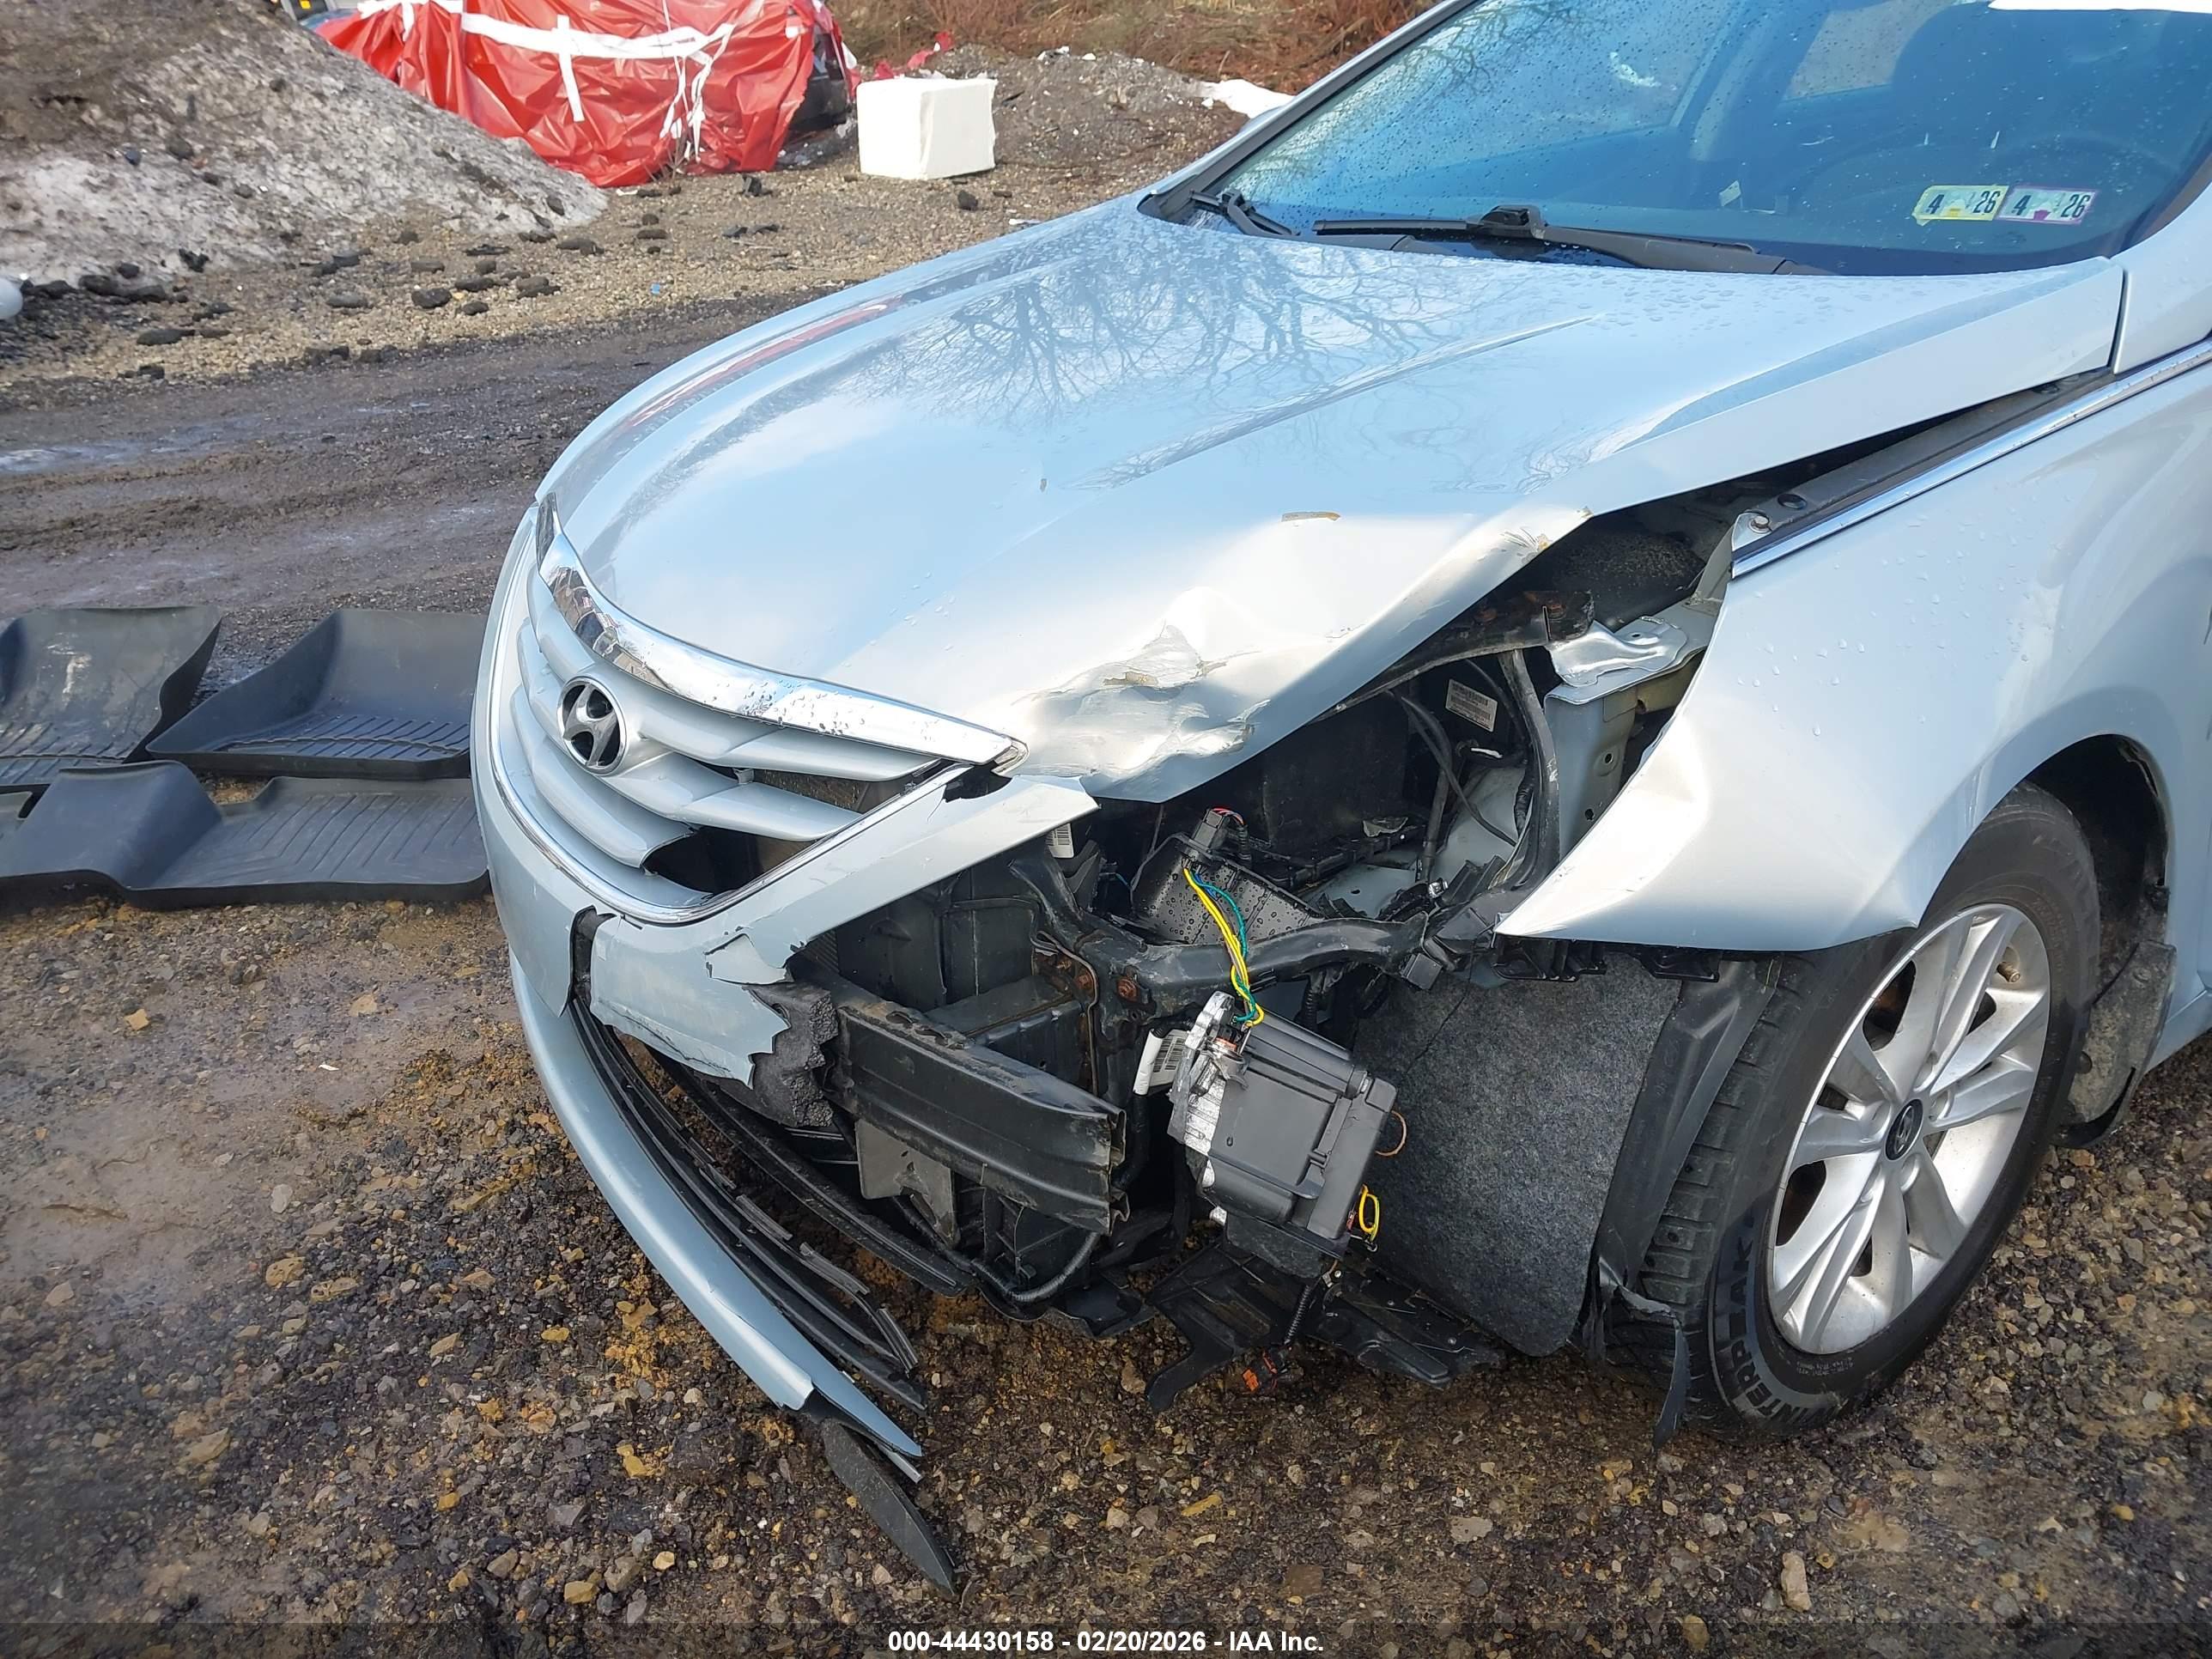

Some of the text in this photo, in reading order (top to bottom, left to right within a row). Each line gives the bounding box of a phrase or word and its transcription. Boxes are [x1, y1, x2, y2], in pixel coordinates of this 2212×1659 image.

[1927, 190, 2002, 215] 4 26
[2011, 193, 2092, 218] 4 26
